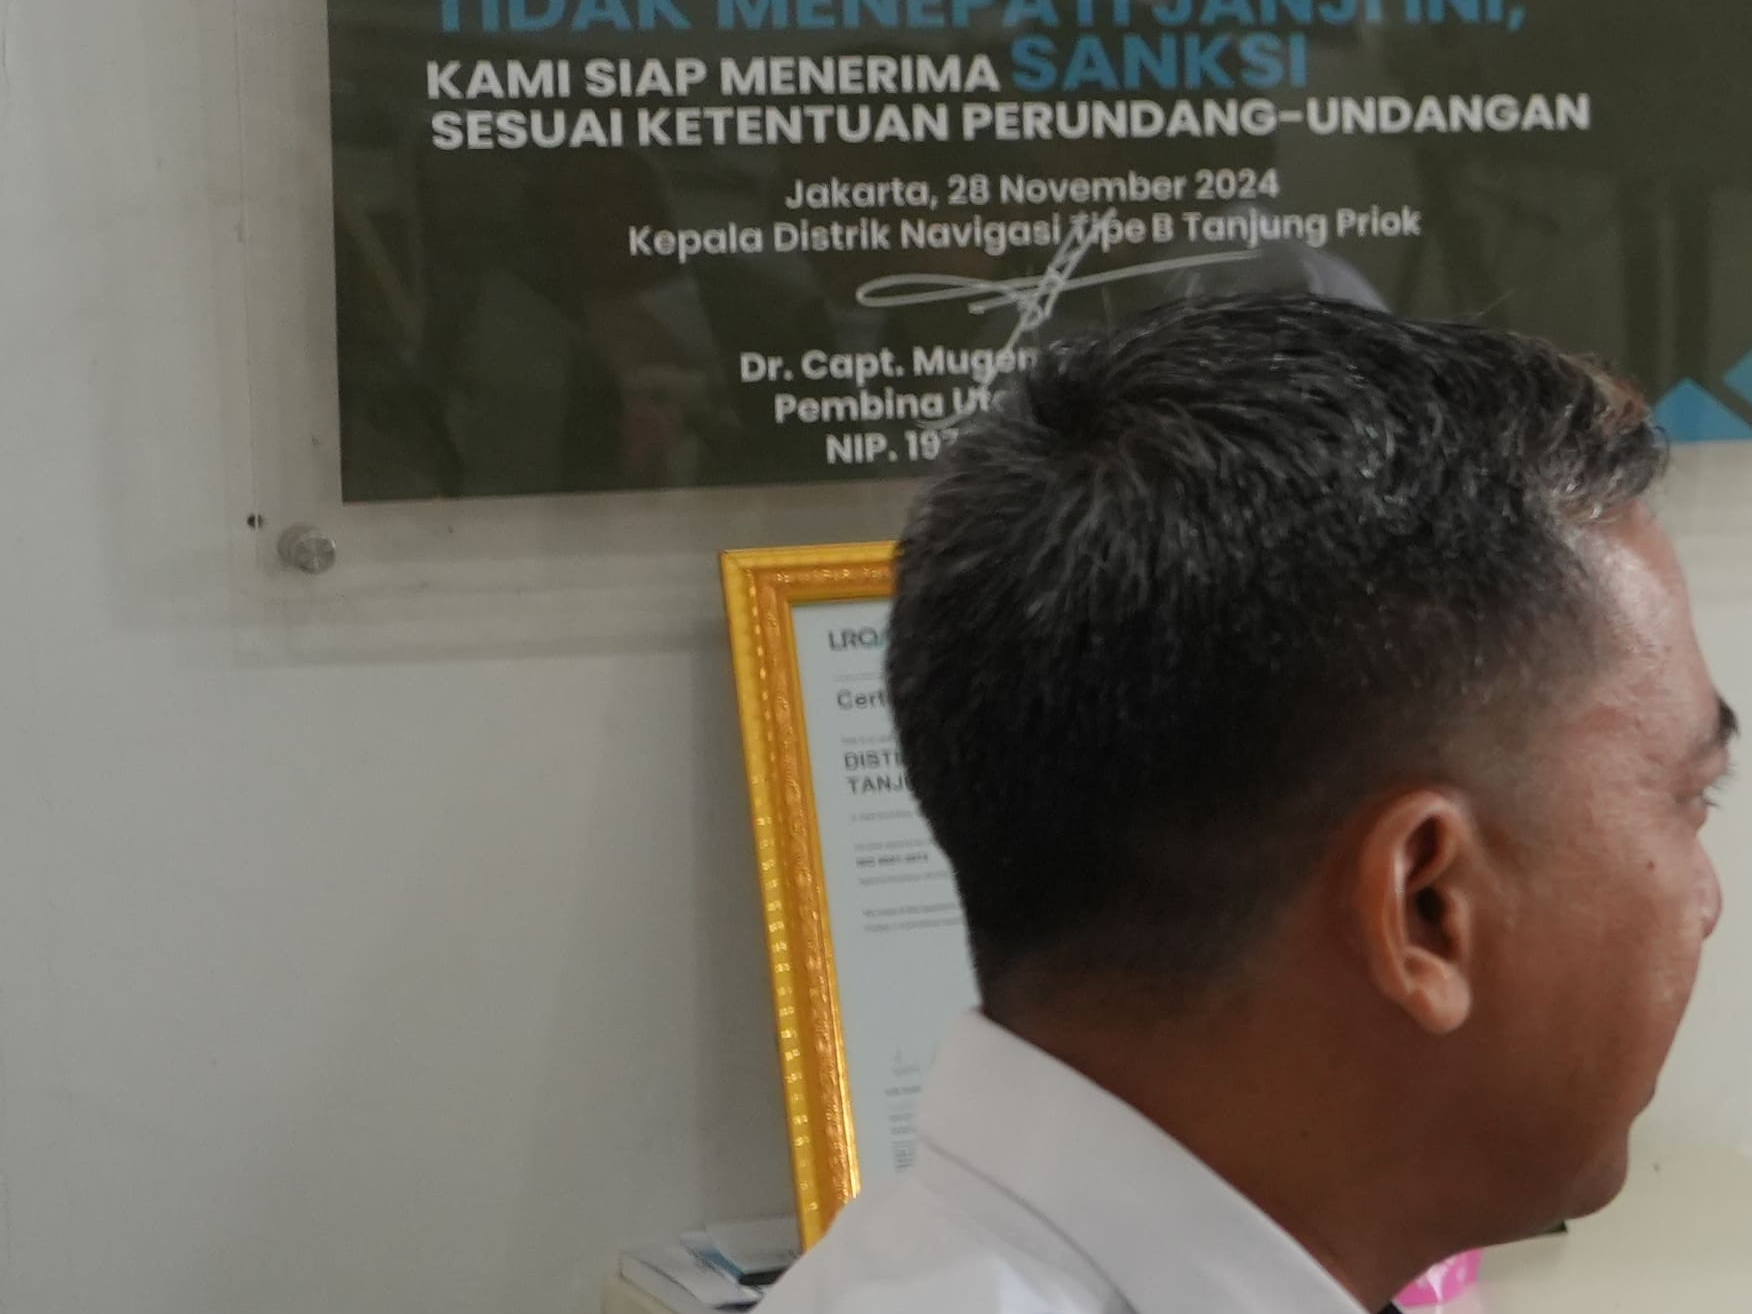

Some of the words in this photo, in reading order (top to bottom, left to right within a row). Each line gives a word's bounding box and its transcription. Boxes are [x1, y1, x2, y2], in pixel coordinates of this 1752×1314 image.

[427, 60, 569, 98] KAMI
[590, 59, 706, 96] SIAP
[721, 55, 999, 94] MENERIMA
[1013, 34, 1306, 90] SANKSI
[432, 110, 622, 149] SESUAI
[638, 104, 948, 145] KETENTUAN
[963, 93, 1589, 139] PERUNDANG-UNDANGAN
[786, 177, 937, 209] Jakarta,
[949, 175, 989, 204] 28
[1000, 171, 1186, 203] November
[1197, 169, 1280, 199] 2024
[630, 223, 763, 263] Kepala
[774, 218, 889, 251] Distrik
[901, 213, 1061, 255] Navigasi
[1071, 211, 1147, 253] Tipe
[1153, 214, 1174, 243] B
[1185, 207, 1327, 248] Tanjung
[1337, 205, 1420, 237] Priok
[741, 353, 792, 381] Dr.
[802, 349, 903, 387] Capt.
[775, 388, 944, 423] Pembina
[953, 390, 1001, 417] Ut
[827, 434, 897, 463] NIP.
